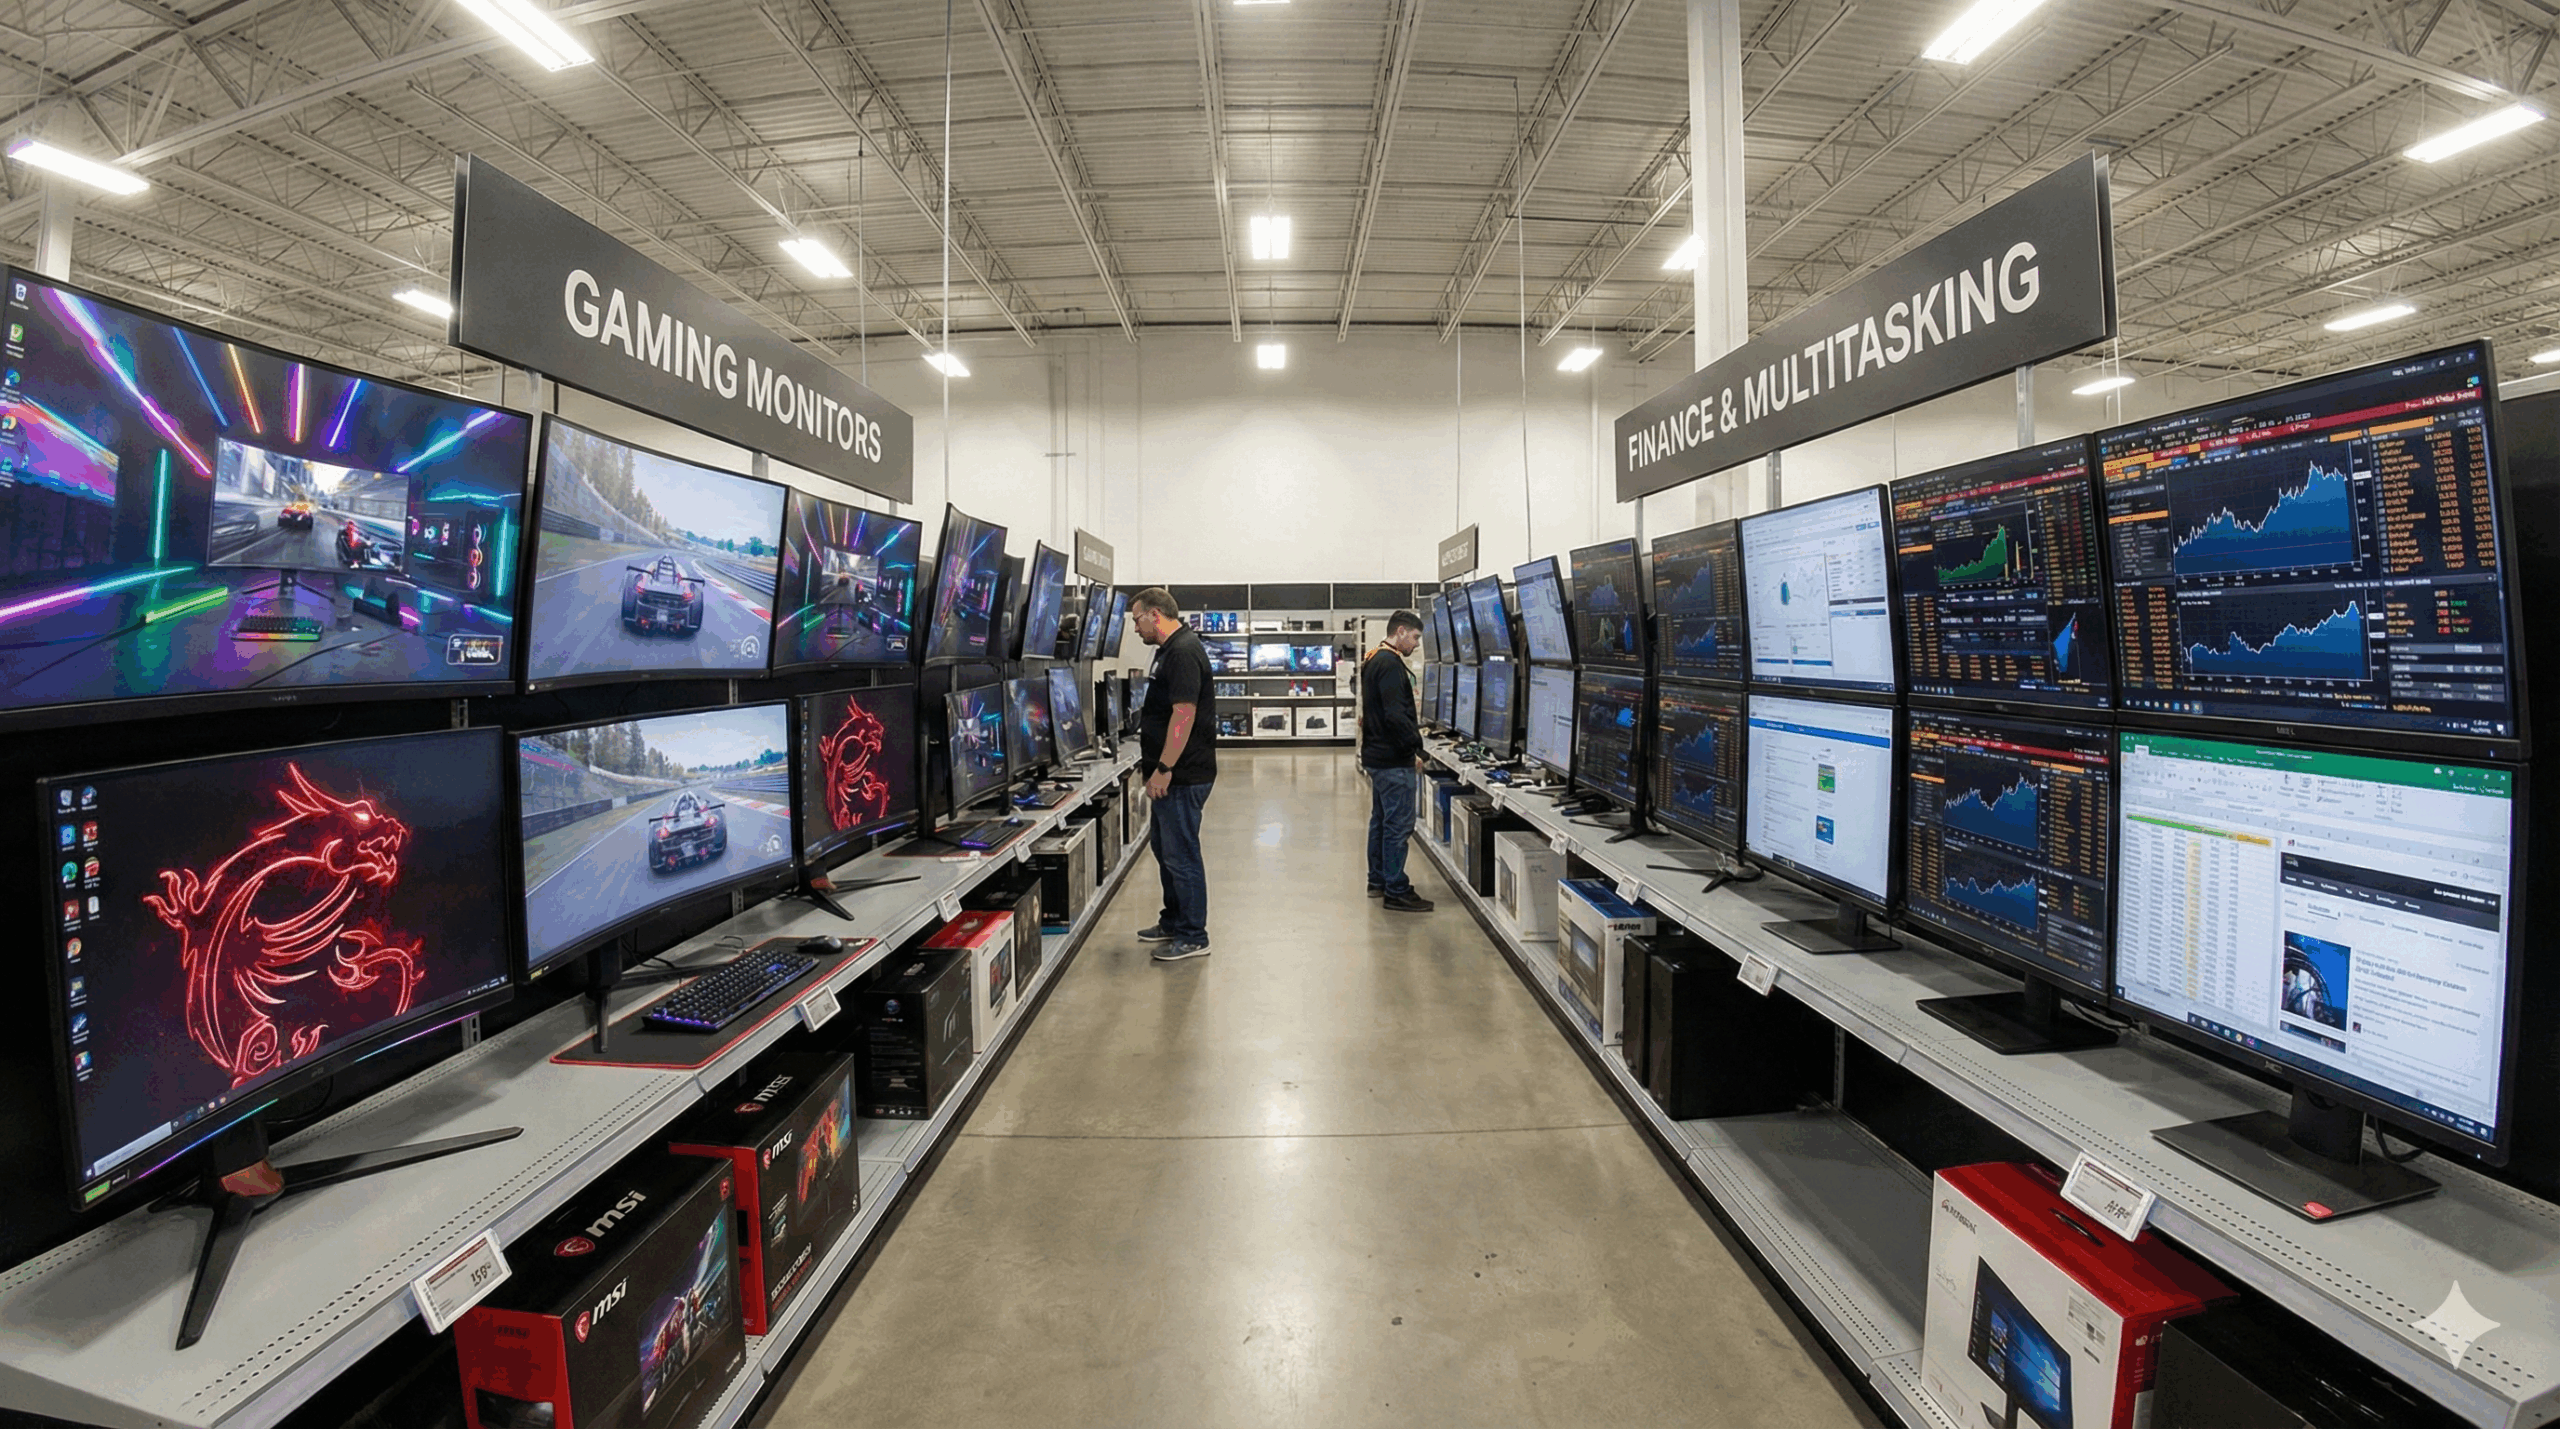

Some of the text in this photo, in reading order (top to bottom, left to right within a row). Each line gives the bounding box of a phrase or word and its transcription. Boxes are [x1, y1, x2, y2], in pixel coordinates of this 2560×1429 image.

[565, 269, 882, 463] GAMING MONITORS
[1628, 241, 2040, 472] FINANCE & MULTITASKING
[585, 1190, 647, 1237] msi
[592, 1275, 630, 1326] msi
